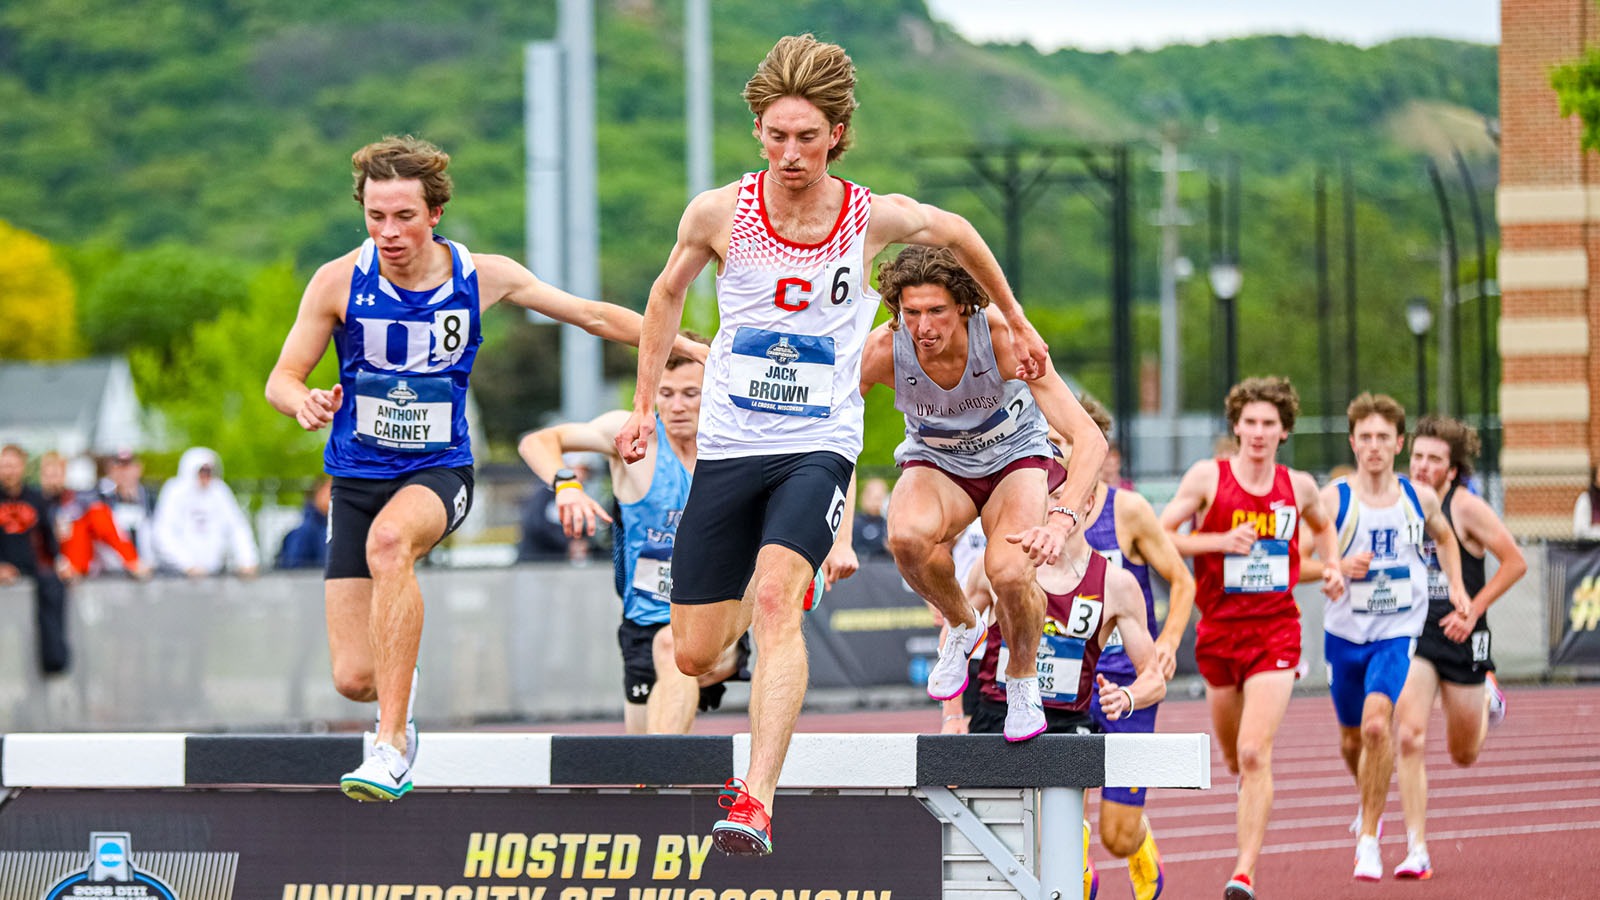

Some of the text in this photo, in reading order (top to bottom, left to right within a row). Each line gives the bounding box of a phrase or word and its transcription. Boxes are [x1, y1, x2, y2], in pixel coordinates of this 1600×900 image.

[773, 276, 813, 312] C
[831, 267, 850, 305] 6
[443, 315, 461, 352] 8
[765, 365, 798, 382] JACK
[748, 379, 809, 403] BROWN
[377, 405, 429, 422] ANTHONY
[1009, 399, 1023, 421] 2
[374, 420, 431, 441] CARNEY
[831, 499, 845, 533] 6
[1281, 512, 1290, 539] 7
[1368, 529, 1398, 560] H
[1408, 524, 1420, 543] 11
[1367, 597, 1398, 612] QUINN
[1073, 603, 1093, 634] 3
[1036, 661, 1054, 673] LER
[463, 832, 713, 881] HOSTED BY
